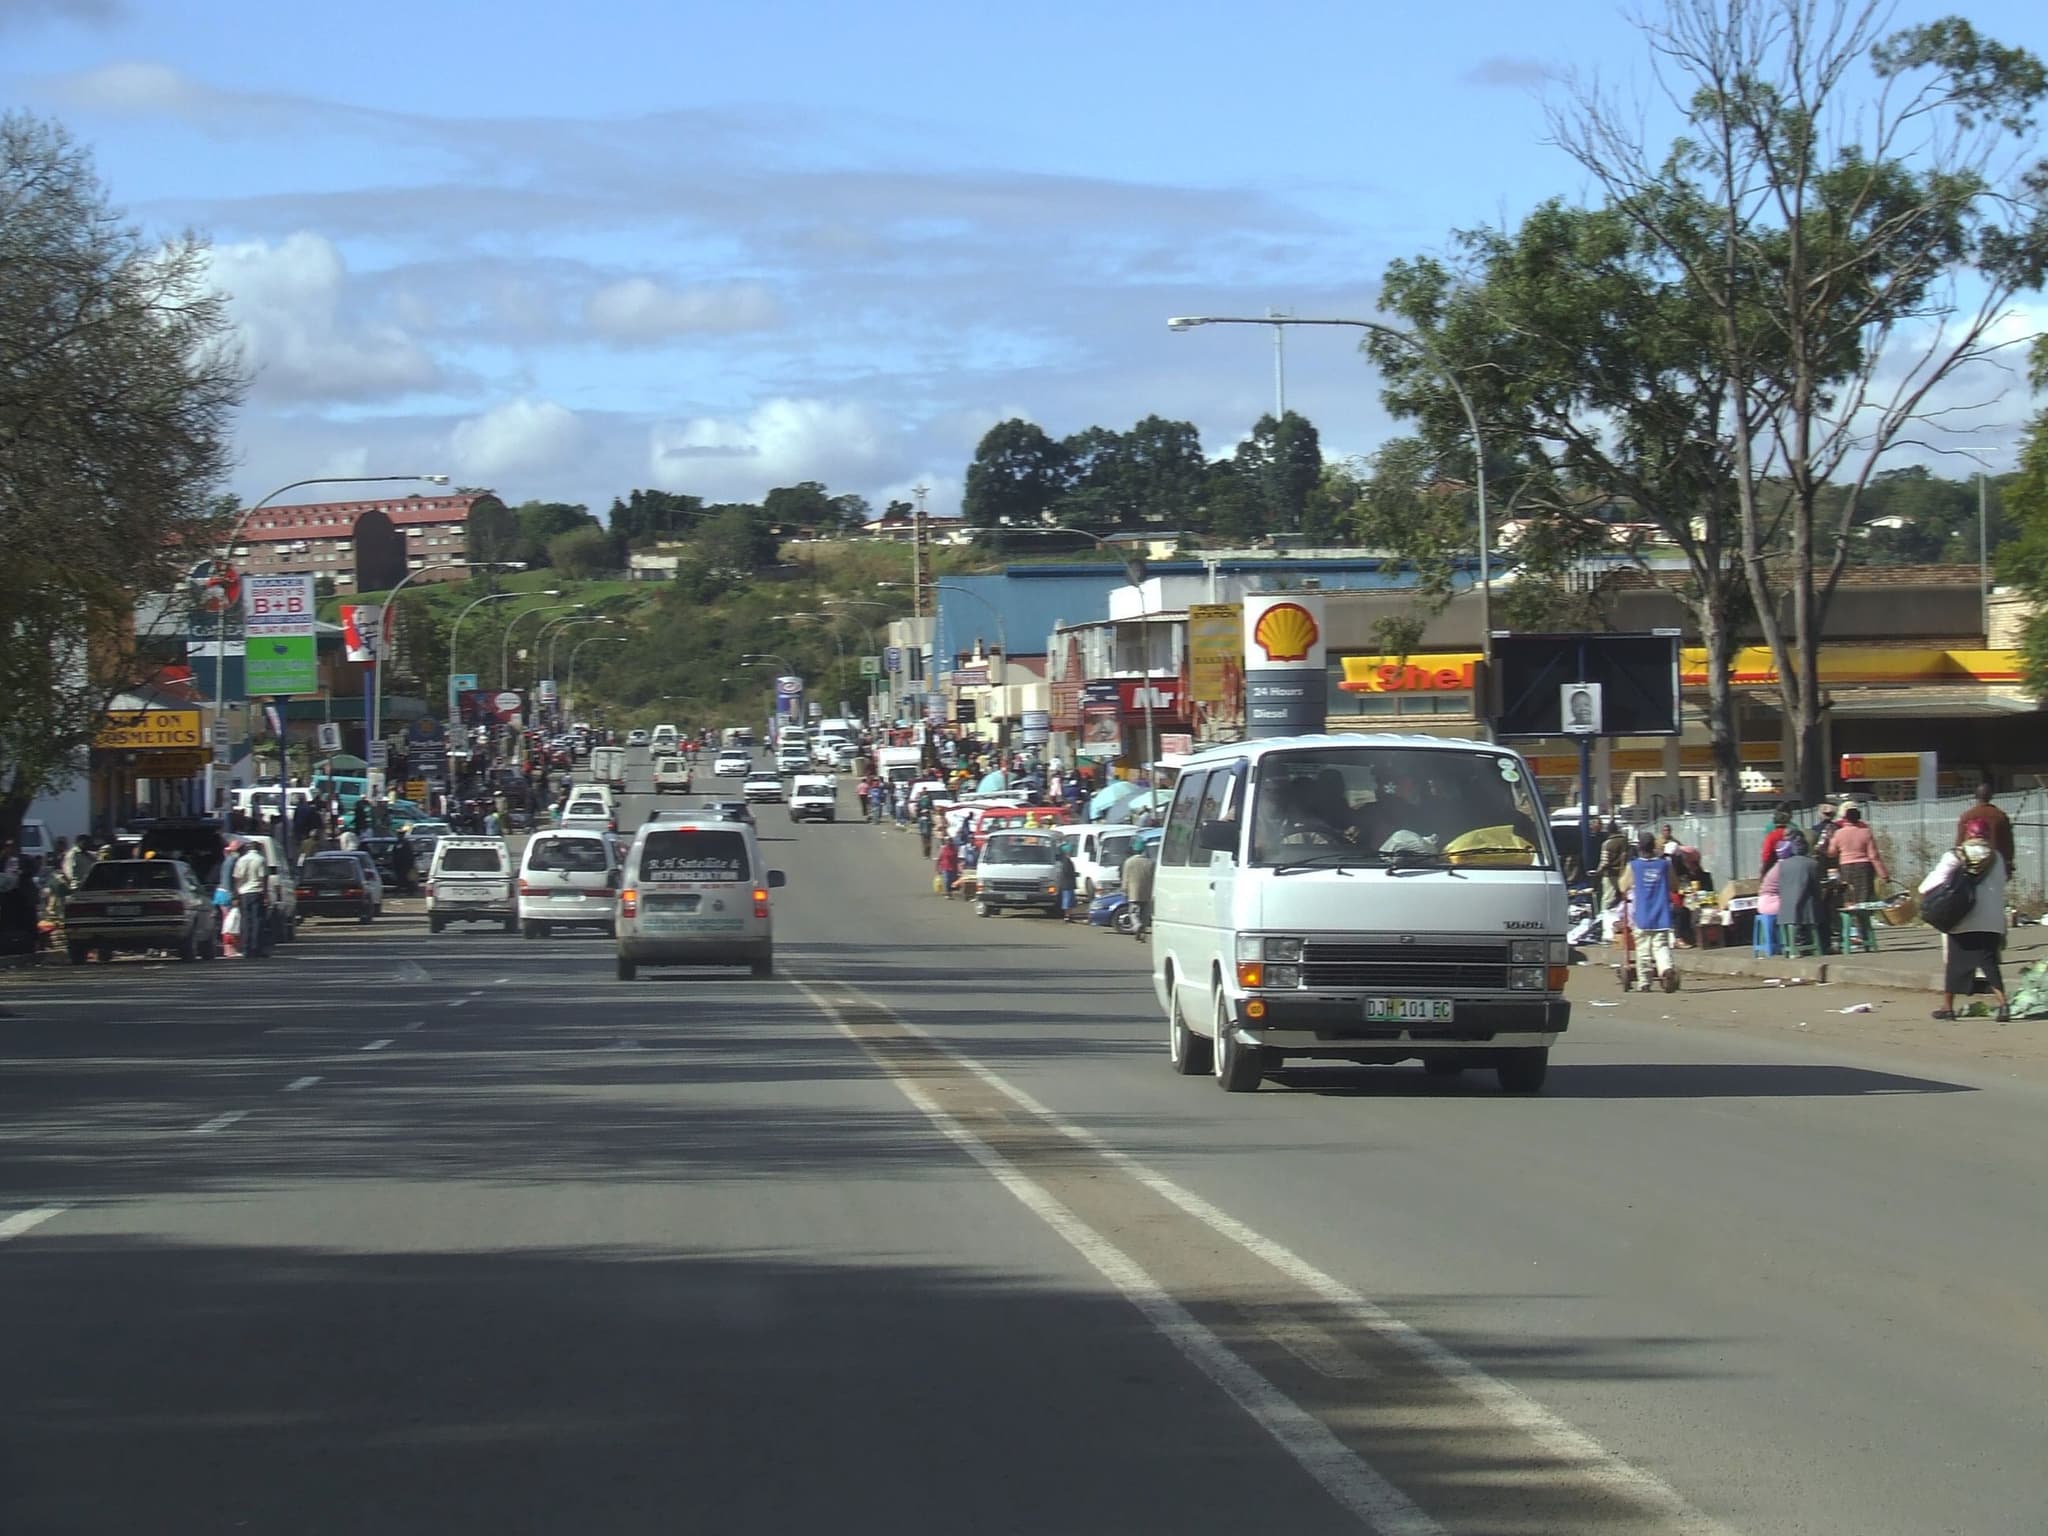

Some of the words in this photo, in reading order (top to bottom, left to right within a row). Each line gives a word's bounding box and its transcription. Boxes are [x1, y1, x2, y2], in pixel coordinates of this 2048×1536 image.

[255, 597, 303, 614] B+B
[1376, 663, 1473, 690] Shel
[1253, 687, 1269, 697] 24
[1269, 687, 1304, 696] Hours
[1253, 708, 1289, 719] Diesel
[157, 715, 182, 727] ON
[1367, 1000, 1394, 1017] DJH
[1400, 1000, 1427, 1017] 101
[1433, 1000, 1450, 1017] EC
